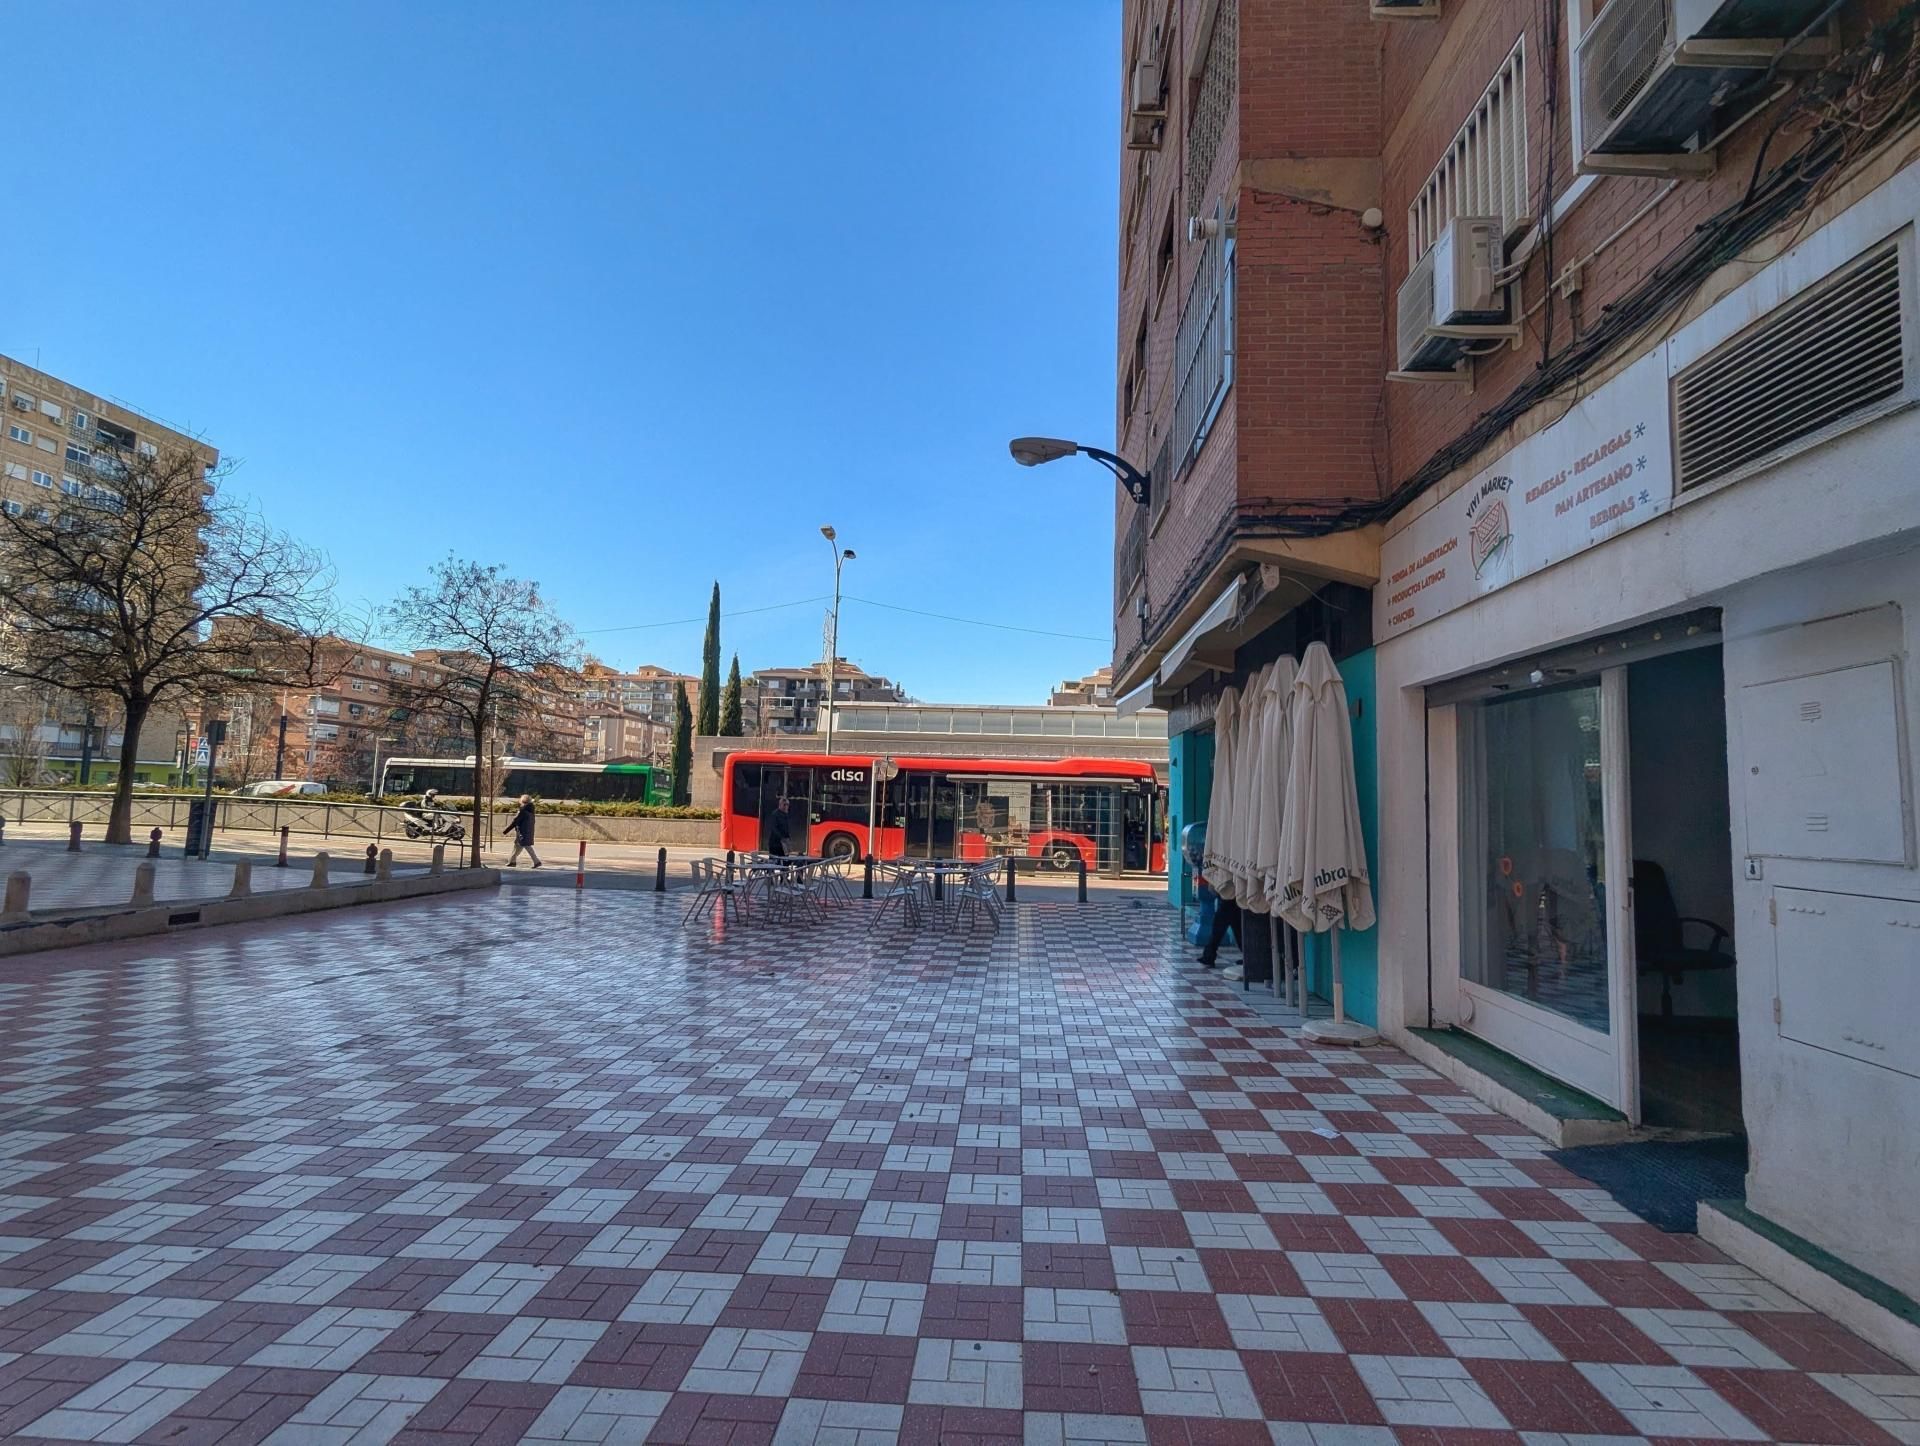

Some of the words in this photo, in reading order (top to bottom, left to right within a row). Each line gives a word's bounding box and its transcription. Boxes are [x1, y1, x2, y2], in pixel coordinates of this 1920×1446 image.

[1525, 470, 1566, 504] REMESAS
[1574, 429, 1632, 476] RECARGAS
[1481, 476, 1514, 499] MARKET
[1555, 495, 1574, 518] PAN
[1576, 463, 1633, 506] ARTESANO
[1590, 495, 1635, 529] BEBIDAS
[1391, 568, 1409, 584] TIENDA
[1409, 562, 1416, 575] DE
[1391, 581, 1421, 605] PRODUCTOS
[1421, 568, 1446, 590] LATINOS
[1392, 607, 1415, 625] CHUCHES
[831, 768, 864, 782] alsa
